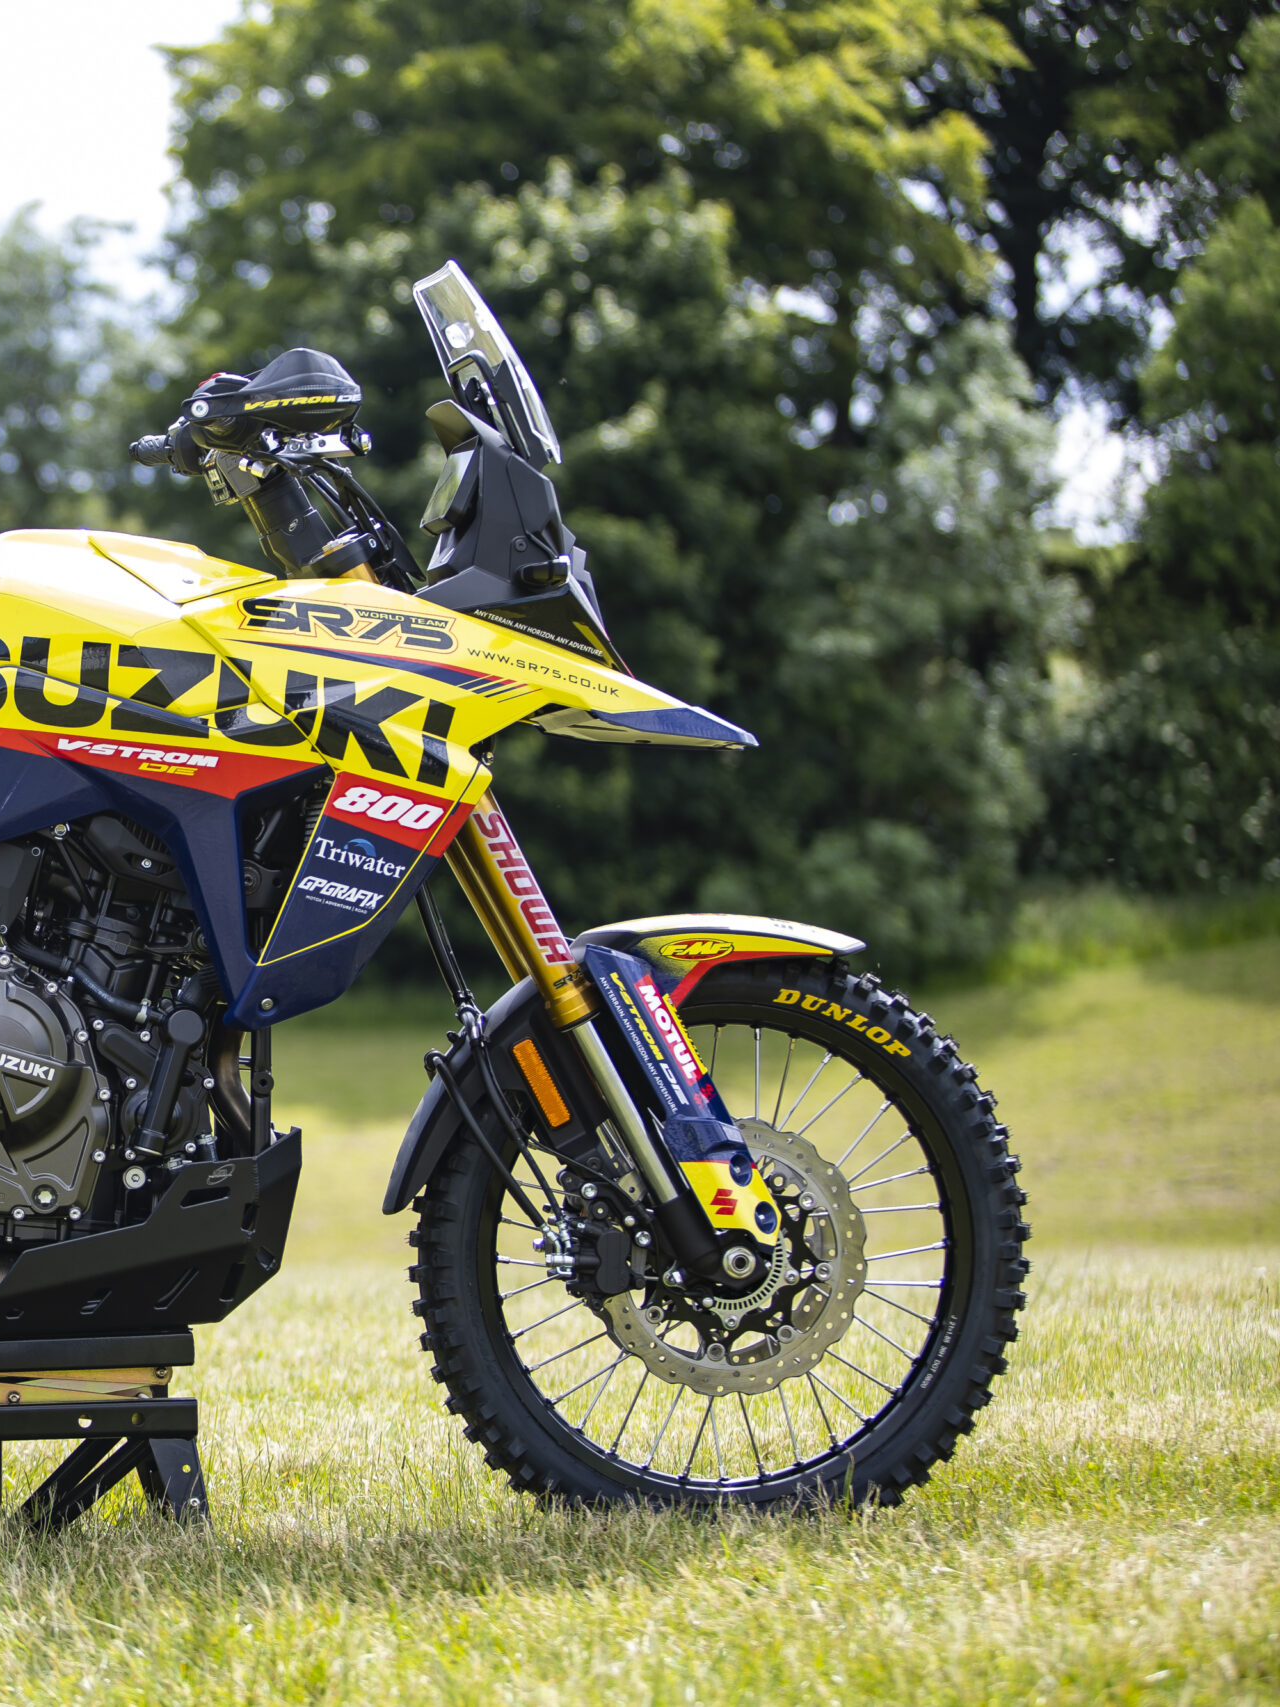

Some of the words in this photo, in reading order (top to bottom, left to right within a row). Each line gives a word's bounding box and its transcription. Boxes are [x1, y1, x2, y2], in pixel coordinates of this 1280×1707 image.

[244, 395, 337, 411] V-STROM
[337, 394, 362, 403] DE
[242, 597, 455, 650] SR75
[358, 609, 405, 622] WORLD
[410, 616, 447, 628] TEAM
[474, 609, 488, 619] ANY
[514, 621, 527, 631] ANY
[556, 635, 569, 645] ANY
[467, 648, 620, 697] WWW.SR75.CO.UK
[57, 738, 219, 768] V-STROM
[138, 762, 198, 776] DE
[332, 786, 445, 830] 800
[315, 837, 406, 878] Triwater
[298, 876, 384, 909] GPGRAFIX
[471, 811, 575, 965] SHOWA
[662, 941, 733, 956] FMF
[599, 976, 612, 990] ANY
[622, 1018, 634, 1035] ANY
[646, 1062, 659, 1076] ANY
[610, 972, 664, 1060] V-STROM
[639, 984, 698, 1079] MOTUL
[773, 988, 911, 1057] DUNLOP
